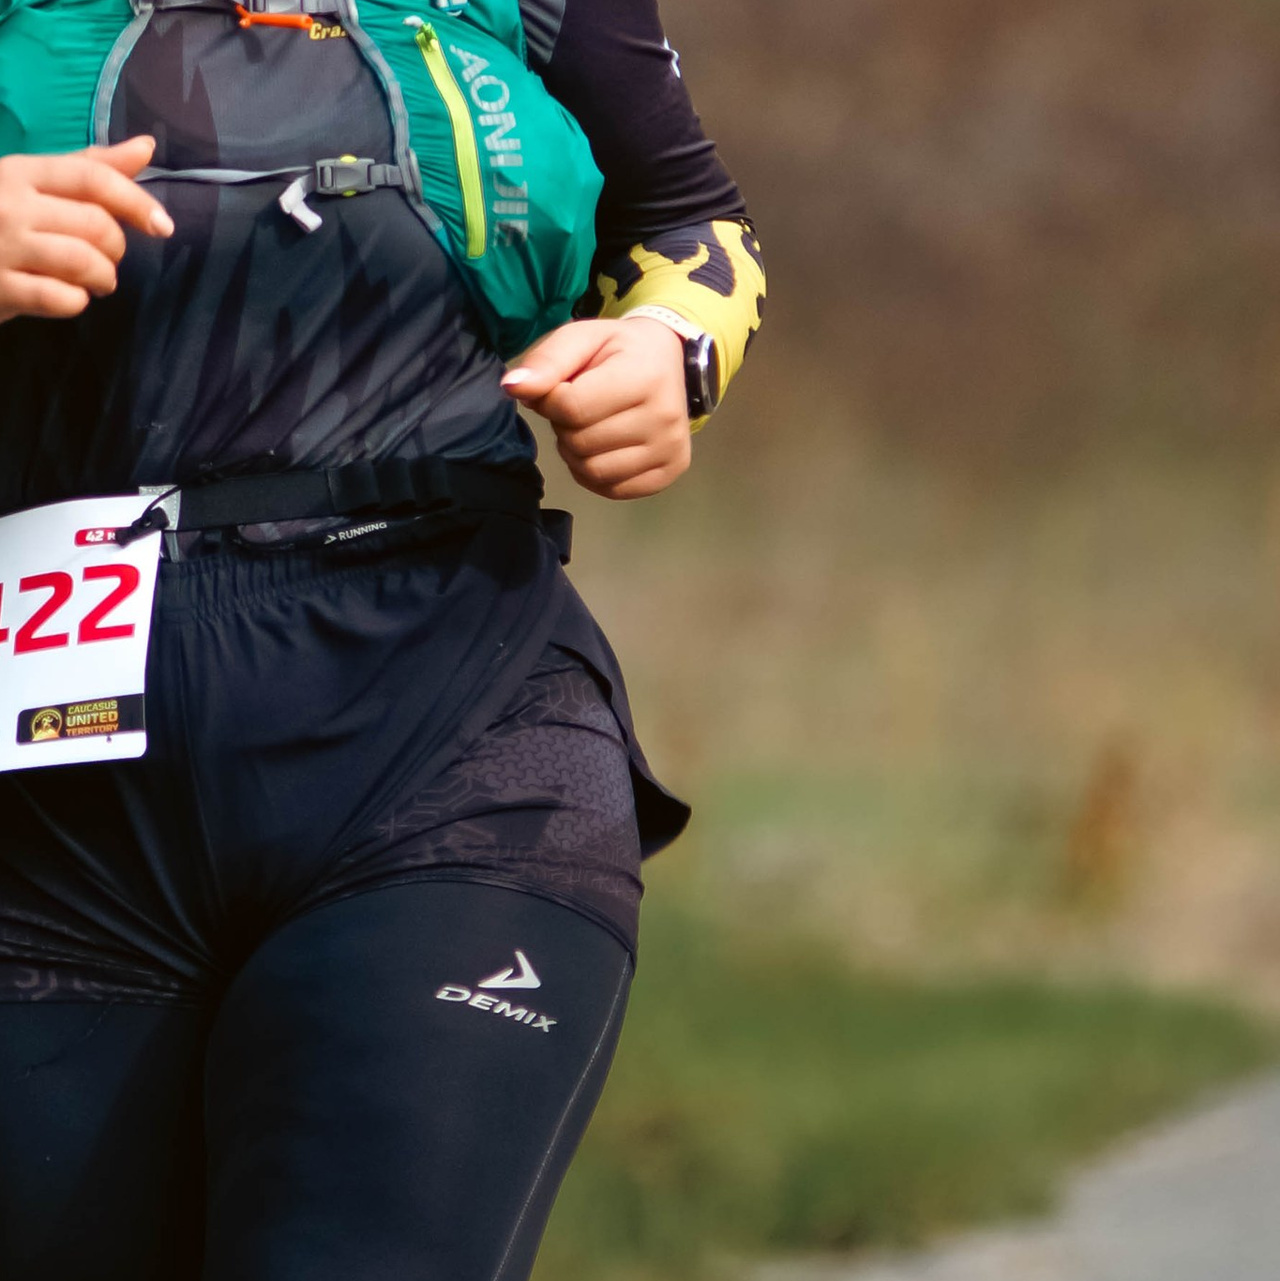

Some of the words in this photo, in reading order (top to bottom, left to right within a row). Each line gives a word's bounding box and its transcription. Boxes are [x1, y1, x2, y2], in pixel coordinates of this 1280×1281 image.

[450, 44, 529, 248] AONIJIE
[85, 529, 104, 542] 42
[338, 522, 387, 540] RUNNING
[68, 700, 118, 715] CAUCASUS
[66, 711, 119, 727] UNITED
[66, 723, 119, 737] TERRITORY
[435, 986, 558, 1033] DEMIX
